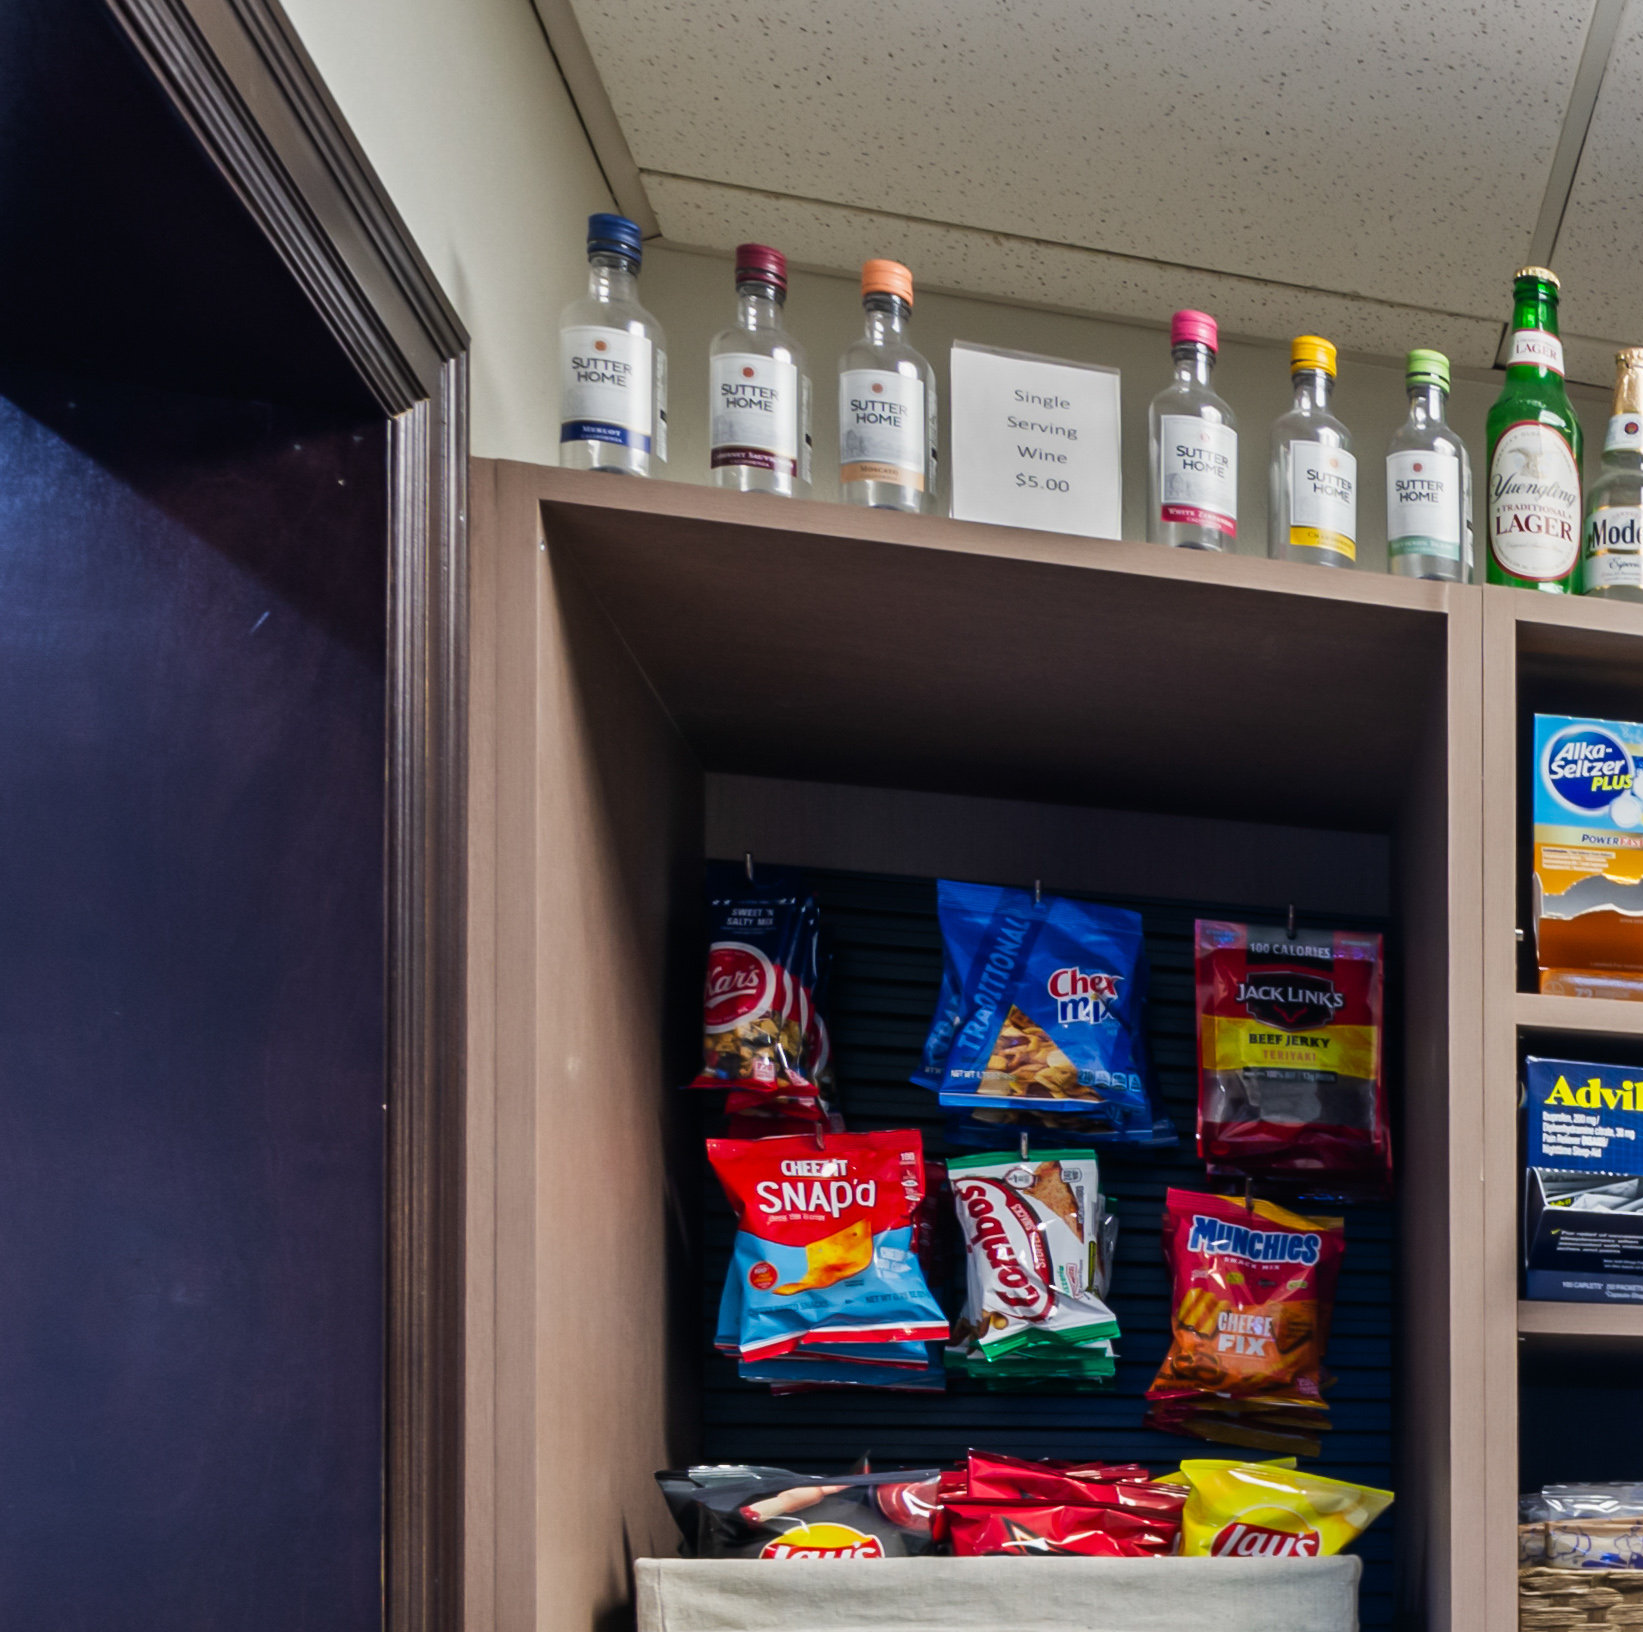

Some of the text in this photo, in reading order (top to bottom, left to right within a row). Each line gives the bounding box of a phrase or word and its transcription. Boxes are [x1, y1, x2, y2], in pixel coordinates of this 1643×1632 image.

[1515, 342, 1557, 363] LAGER
[570, 357, 632, 376] SUTTER
[576, 371, 627, 387] HOME
[1013, 389, 1071, 411] Single
[1007, 415, 1078, 440] Serving
[1017, 445, 1068, 465] Wine
[1175, 445, 1229, 469] SUTTER
[1182, 458, 1224, 477] HOME
[1015, 472, 1071, 494] $5.00
[1492, 474, 1577, 507] Yuengling
[1502, 504, 1567, 520] TRADITIONAL
[1495, 514, 1574, 543] LAGER
[1554, 742, 1613, 762] Alka-
[1550, 759, 1625, 780] Seltzer
[1591, 775, 1633, 792] PLUS
[1250, 942, 1332, 959] 100 CALORIES
[957, 915, 1033, 1051] TRADITIONAL
[1047, 967, 1125, 999] Chex
[1236, 983, 1284, 1003] JACK
[1249, 1033, 1331, 1048] BEEF JERKY
[1218, 1311, 1273, 1337] CHEESE
[1217, 1334, 1266, 1357] FIX
